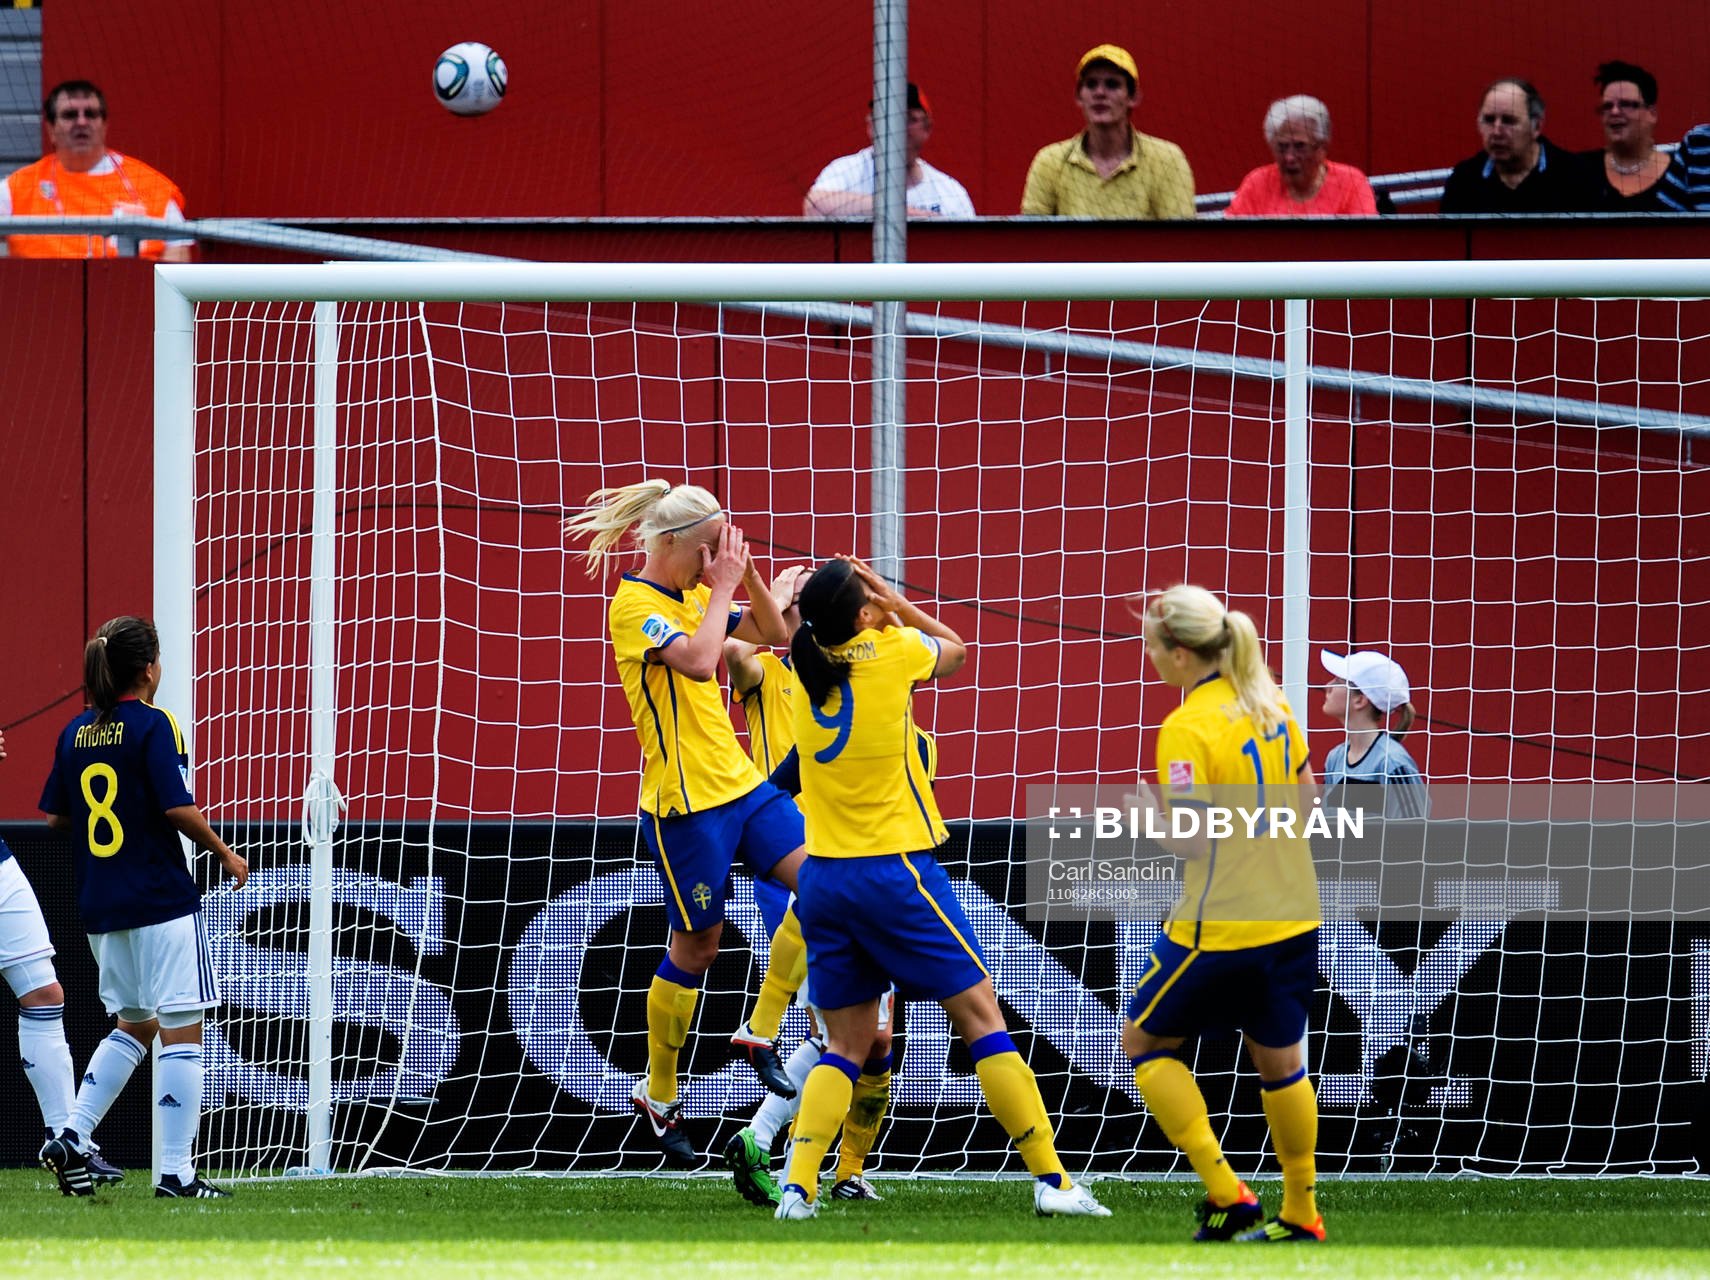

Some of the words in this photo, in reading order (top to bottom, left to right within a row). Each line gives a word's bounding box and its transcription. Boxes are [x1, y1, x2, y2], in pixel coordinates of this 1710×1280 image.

[811, 674, 854, 764] 9
[80, 762, 124, 857] 8
[198, 863, 1560, 1118] SONY
